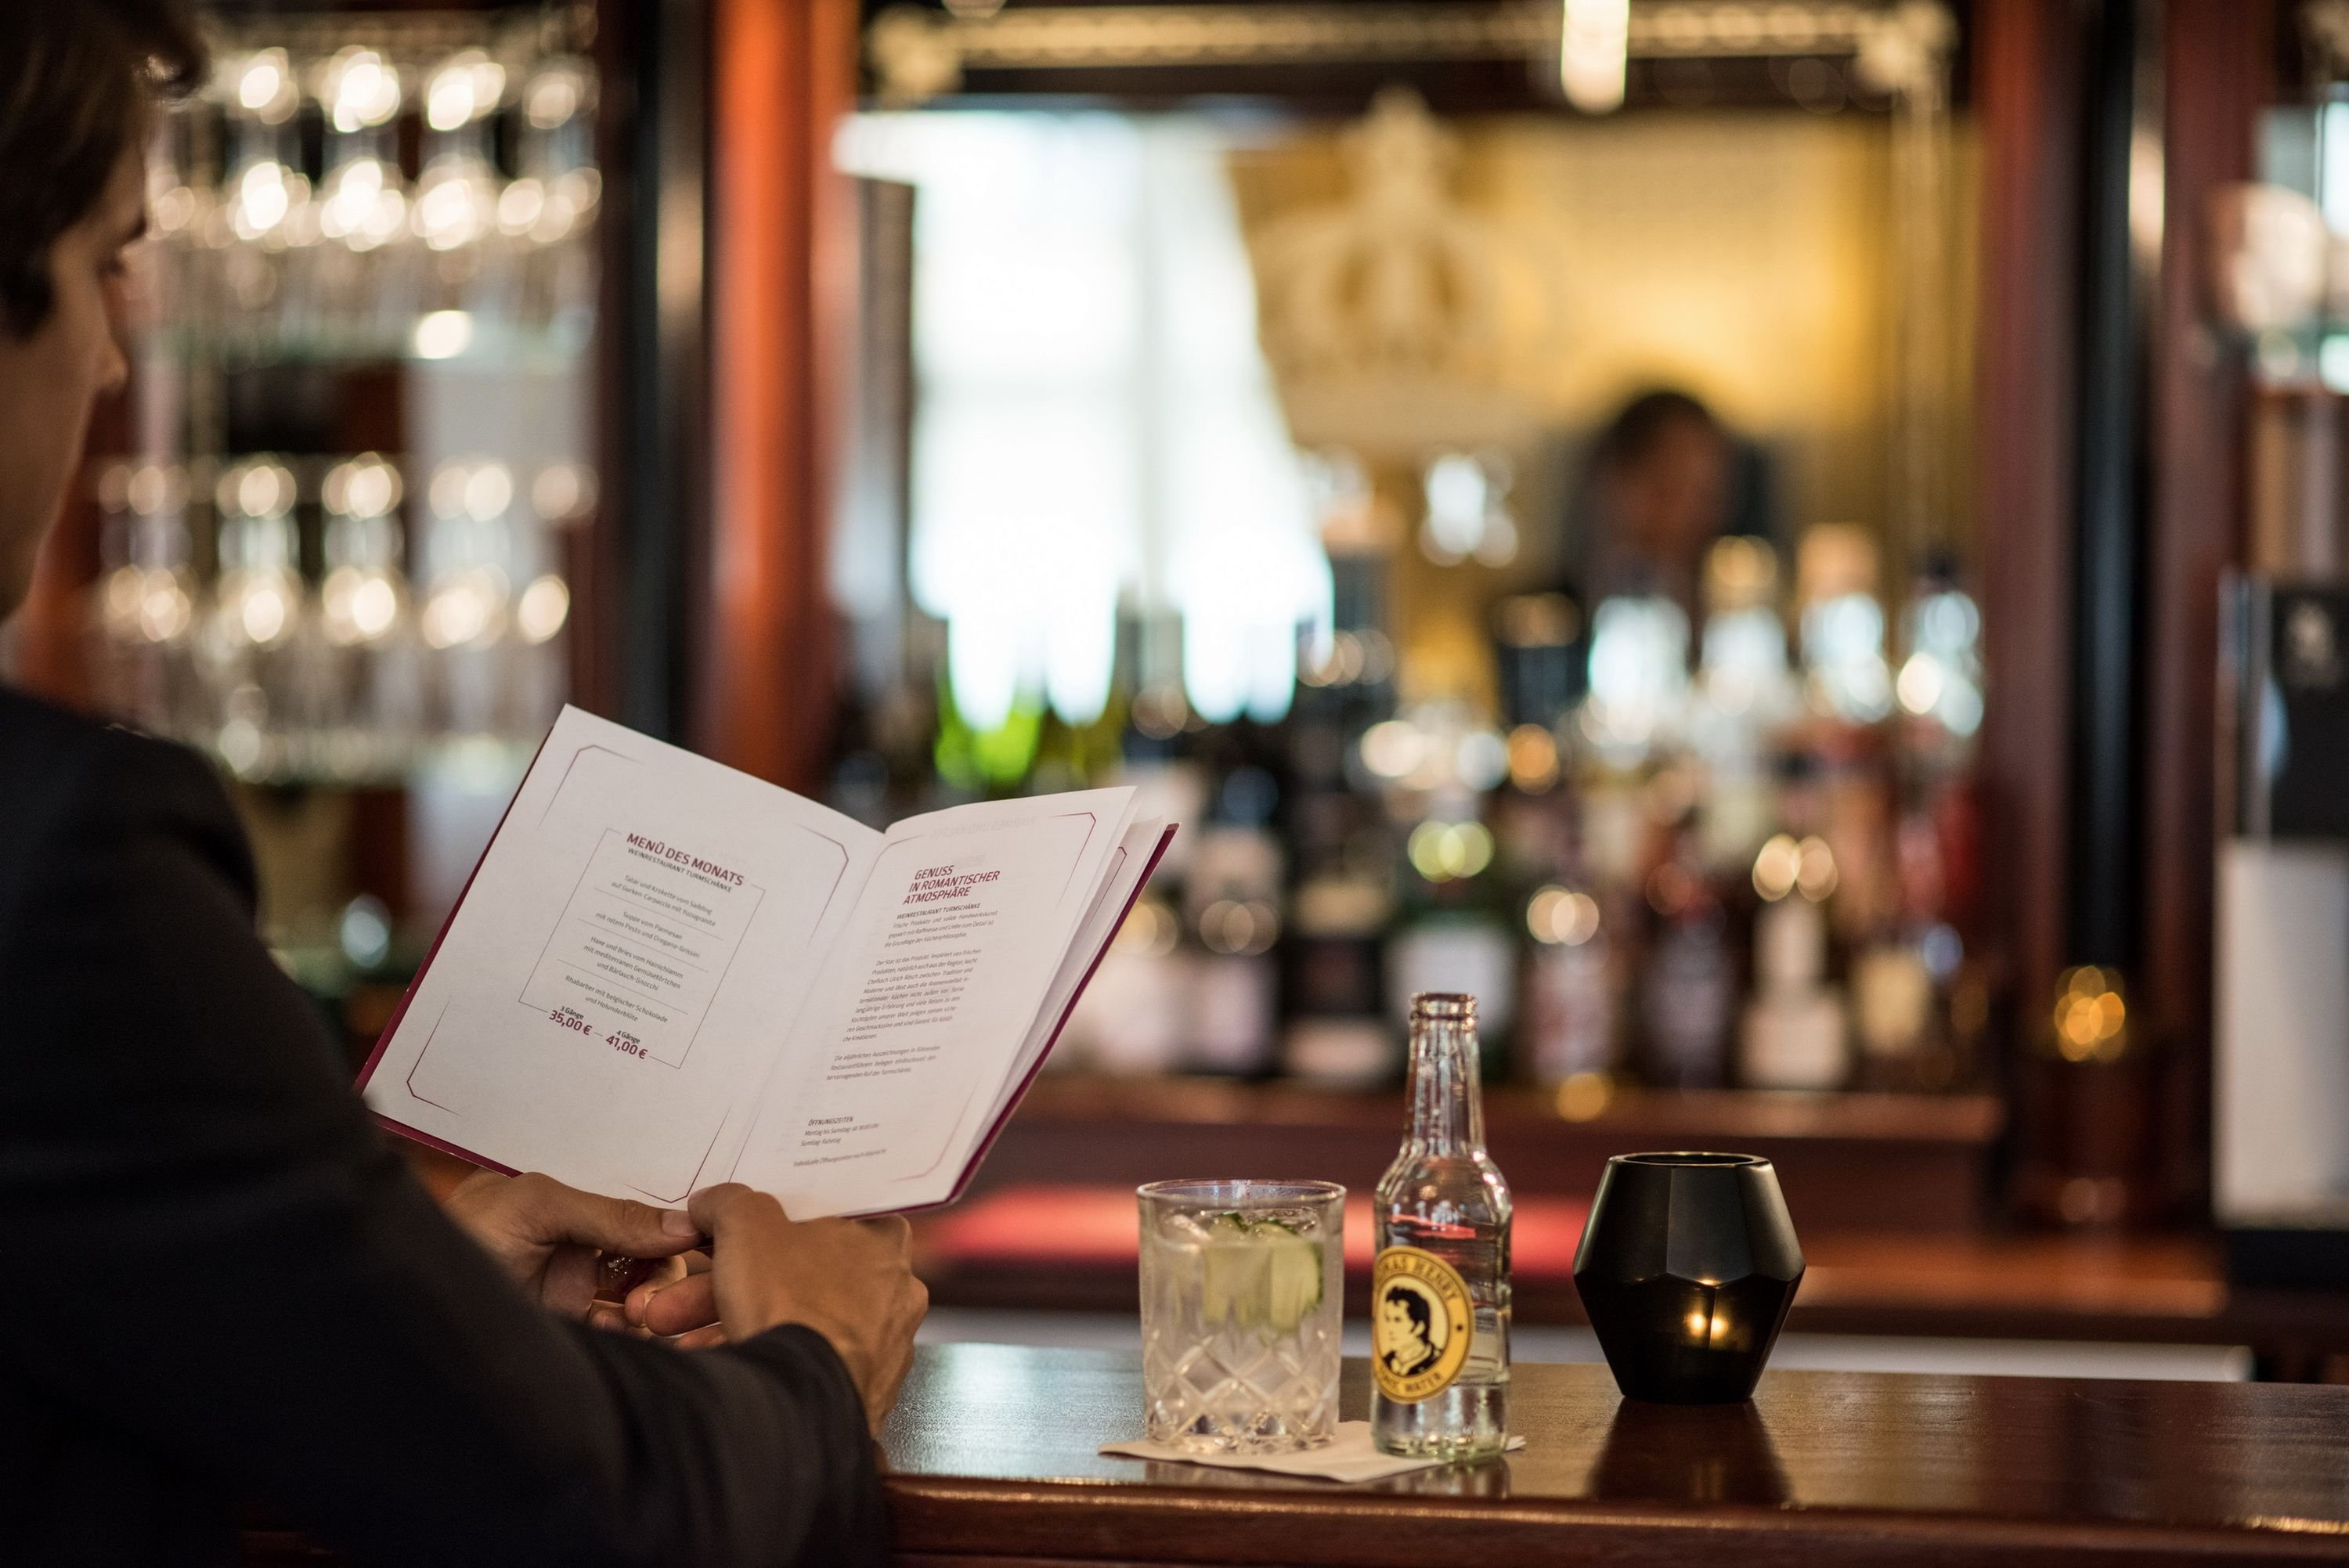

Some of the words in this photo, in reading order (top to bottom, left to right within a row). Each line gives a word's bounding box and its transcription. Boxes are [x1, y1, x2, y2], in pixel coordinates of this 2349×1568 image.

[626, 834, 665, 855] MENÜ
[665, 848, 691, 865] DES
[691, 858, 744, 886] MONATS
[629, 848, 684, 872] WEINRESTAURANT
[687, 871, 731, 892] TURMSCHÄNKE
[908, 882, 922, 892] IN
[921, 871, 1001, 891] ROMANTISCHER
[914, 865, 954, 881] GENUSS
[625, 875, 639, 885] Tatar
[651, 886, 676, 899] Krokette
[677, 896, 689, 905] vom
[690, 901, 713, 915] Saibling
[903, 887, 972, 905] ATMOSPHÄRE
[897, 908, 942, 919] WEINRESTAURANT
[944, 903, 980, 912] TURMSCHÄNKE
[607, 917, 624, 927] rotem
[625, 923, 641, 934] Pesto
[654, 935, 700, 957] Oregano-Grissini
[623, 911, 640, 922] Suppe
[655, 924, 682, 939] Parmesan
[590, 937, 605, 946] Haxe
[618, 947, 632, 957] Bries
[633, 954, 645, 963] vom
[646, 960, 683, 978] Hainichlamm
[594, 950, 633, 969] mediterranen
[633, 965, 680, 989] Gemüsetörtchen
[609, 966, 659, 990] Bärlauch-Gnocchi
[565, 975, 595, 991] Rhabarber
[606, 993, 635, 1008] belgischer
[636, 1005, 667, 1022] Schokolade
[597, 1000, 637, 1021] Holunderblüte
[549, 1010, 583, 1031] 35,00
[582, 1025, 593, 1036] €
[565, 1007, 584, 1021] Gänge
[605, 1036, 638, 1055] 41,00
[637, 1049, 648, 1060] €
[620, 1032, 640, 1045] Gänge
[808, 1116, 853, 1126] ÖFFNUNGSZEITEN
